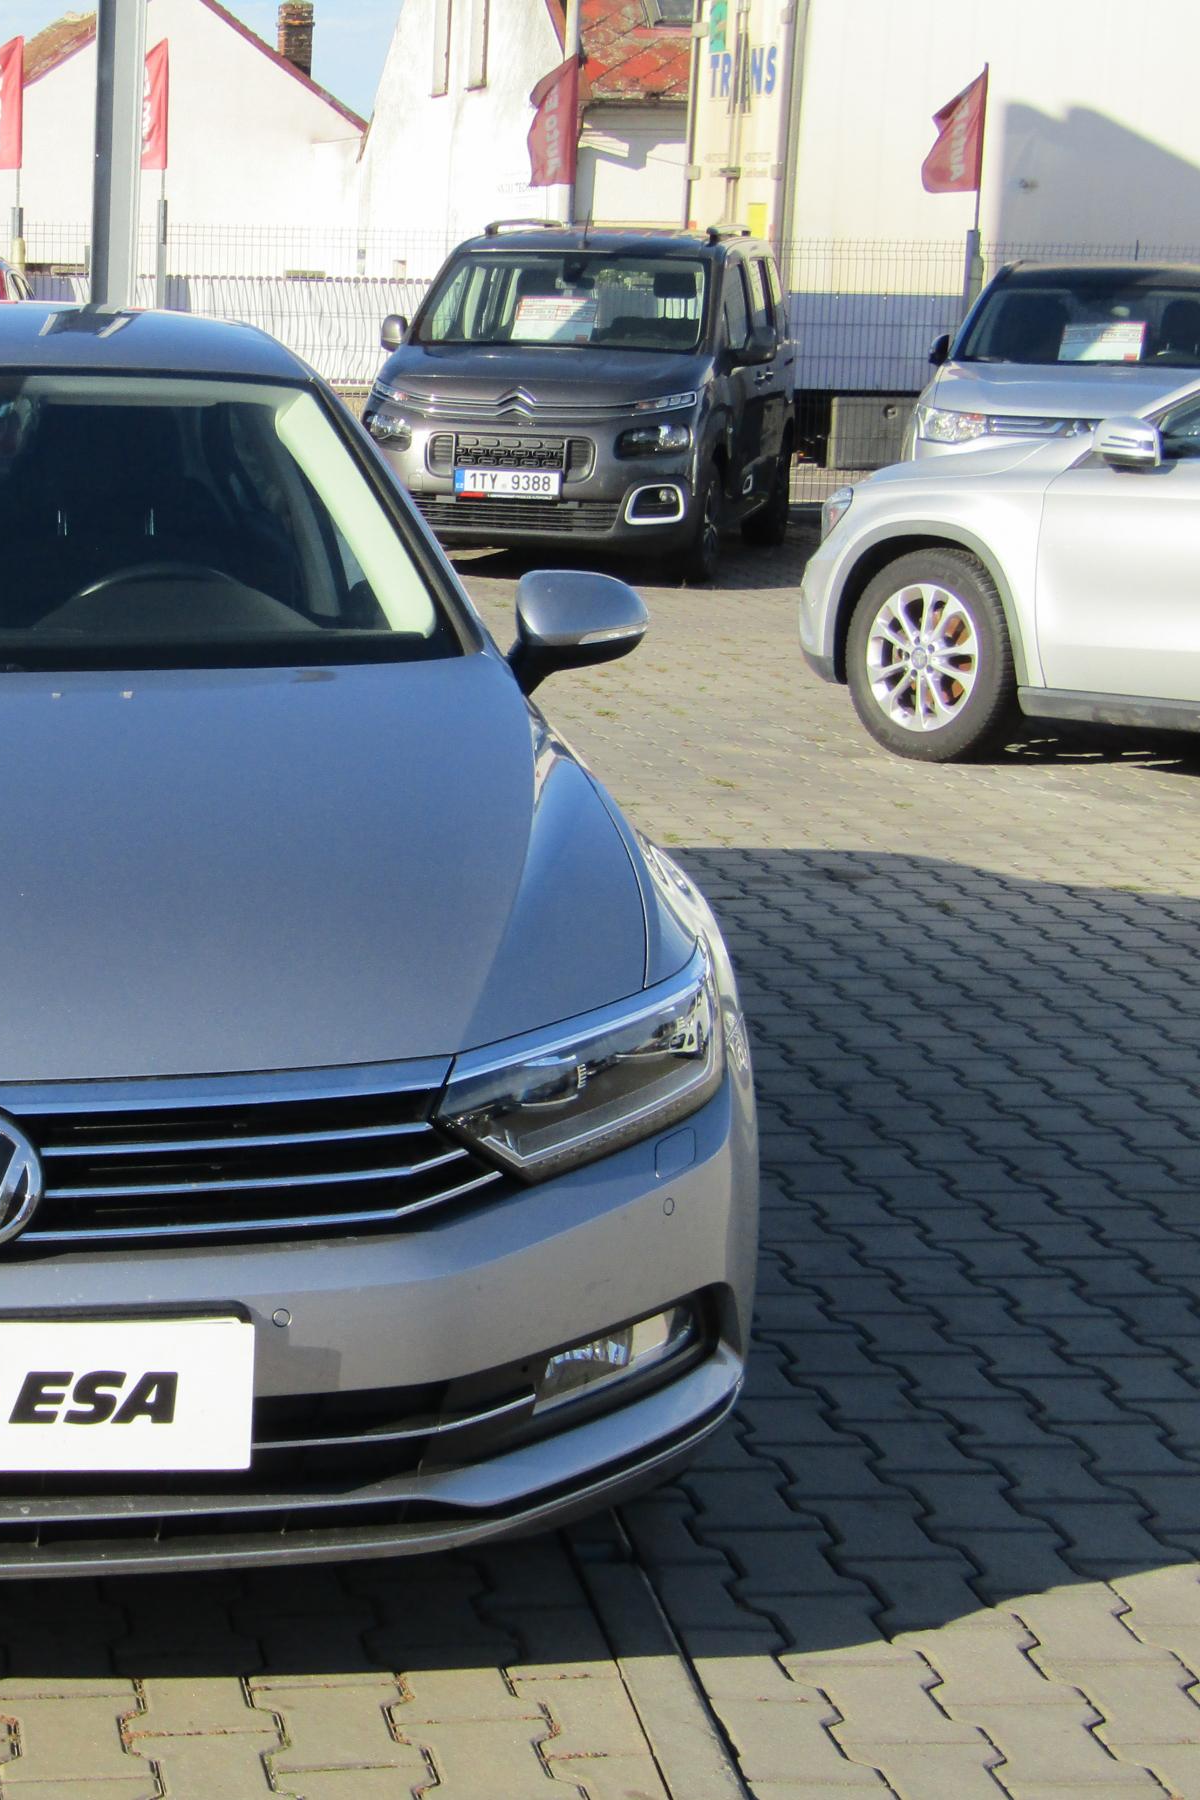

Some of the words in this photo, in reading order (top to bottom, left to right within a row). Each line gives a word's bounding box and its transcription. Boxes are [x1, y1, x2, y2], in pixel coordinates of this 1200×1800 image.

[710, 46, 777, 97] TRNS
[470, 473, 498, 489] 1TY
[511, 475, 551, 491] 9388
[8, 1371, 179, 1424] ESA
